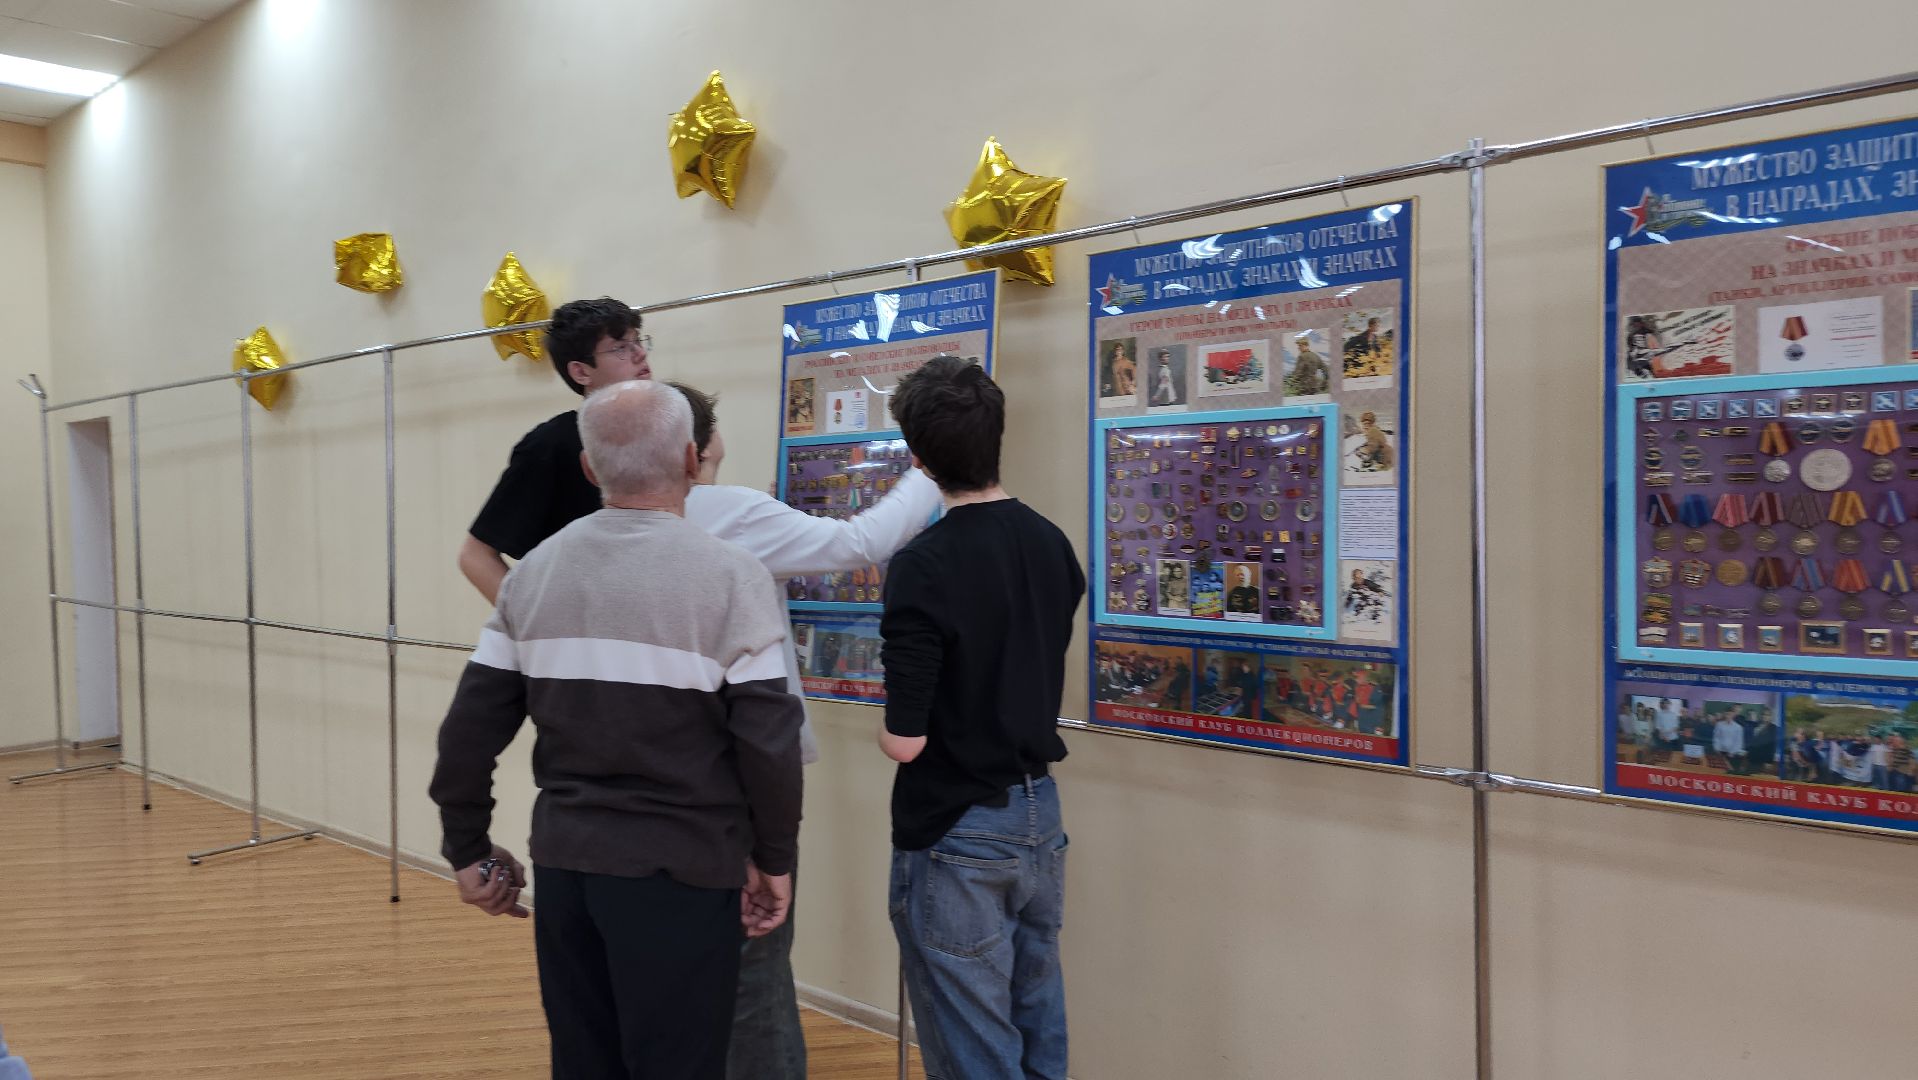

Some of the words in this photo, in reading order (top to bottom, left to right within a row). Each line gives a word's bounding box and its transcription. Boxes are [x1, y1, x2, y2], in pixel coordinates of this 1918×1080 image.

[1692, 149, 1818, 191] МУЖЕСТВО
[1824, 131, 1918, 171] ЗАЩИТ
[1726, 194, 1740, 217] В
[1309, 218, 1399, 250] ОТЕЧЕСТВА
[1153, 281, 1162, 299] В
[1322, 246, 1397, 276] ЗНАЧКАХ
[930, 282, 988, 306] ОТЕЧЕСТВА
[1112, 708, 1194, 728] МОСКОВСКИЙ
[1199, 719, 1233, 733] КЛУБ
[1237, 725, 1374, 752] КОЛЛЕКЦИОНЕРОВ
[1648, 773, 1797, 801] МОСКОВСКИЙ
[1807, 791, 1868, 809] КЛУБ
